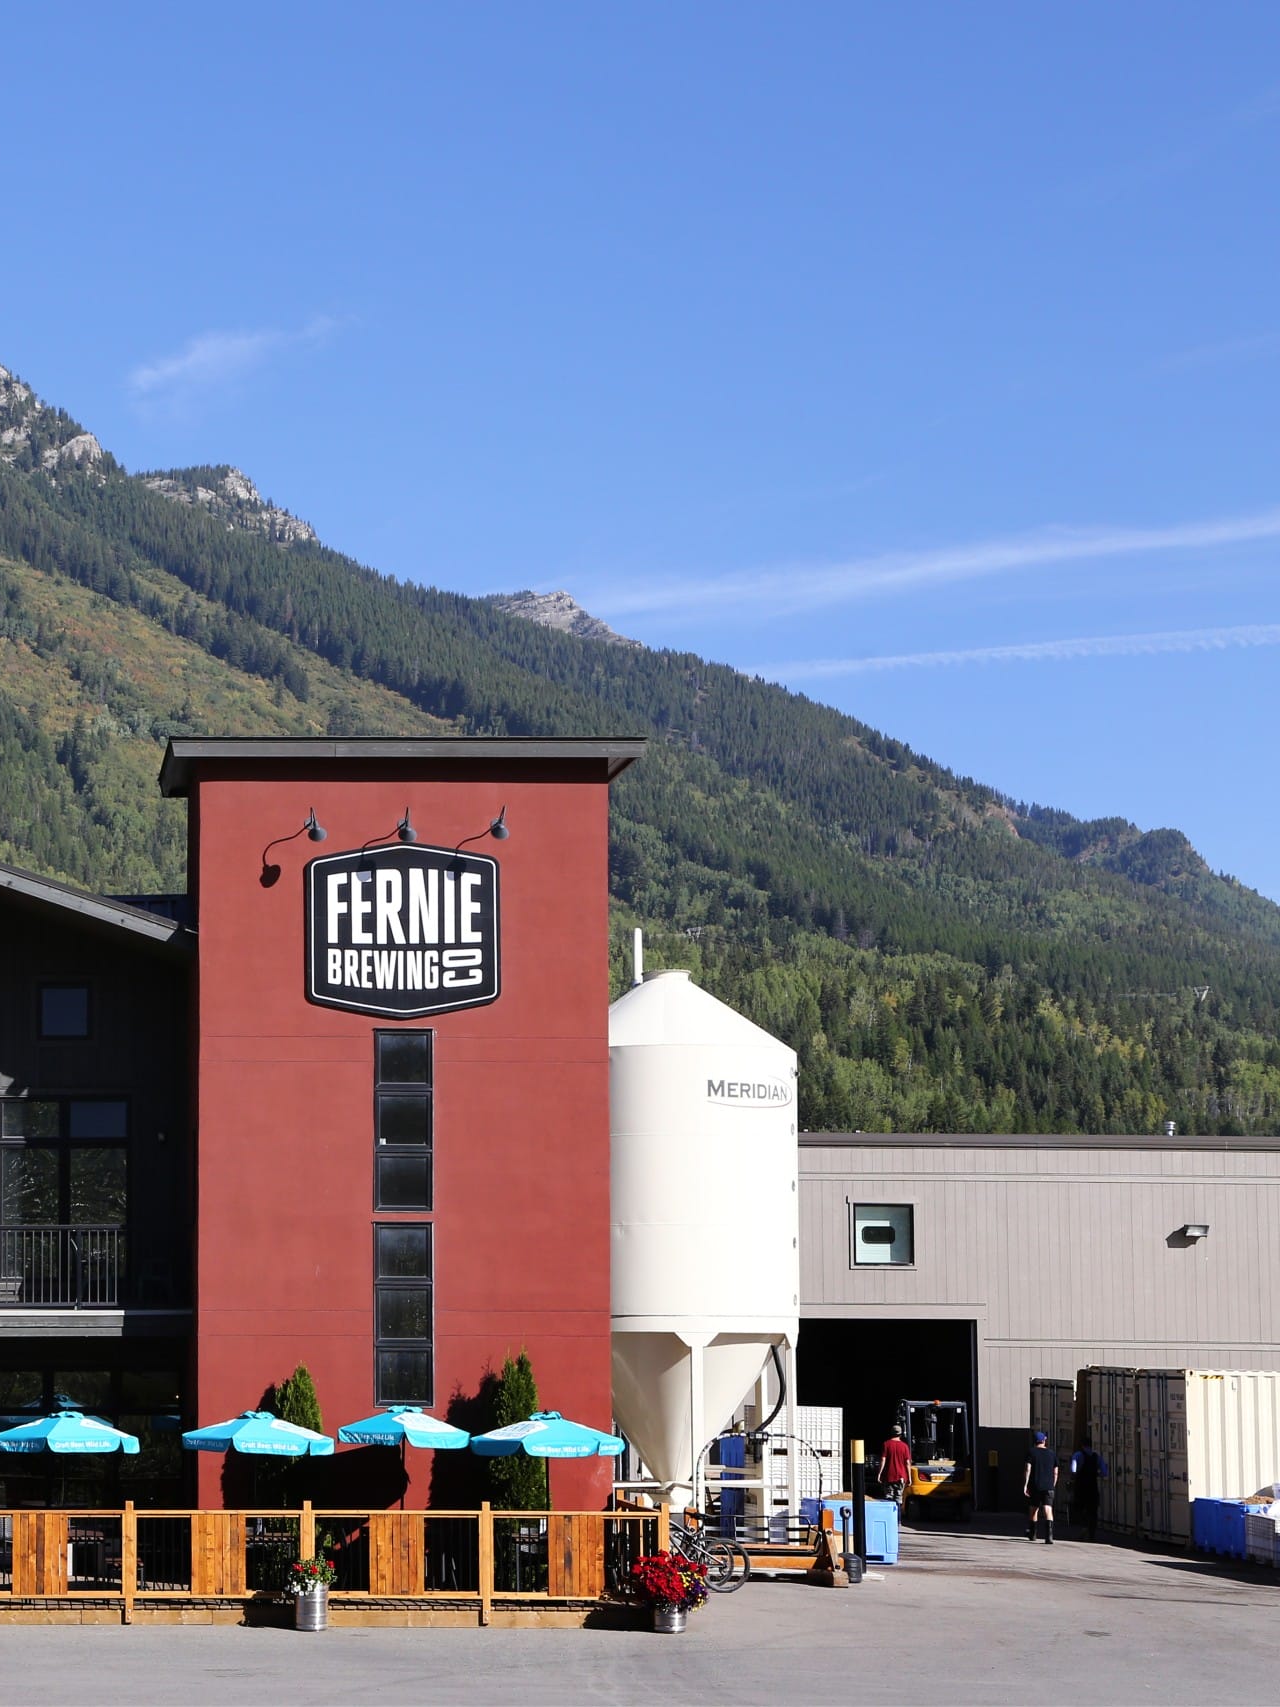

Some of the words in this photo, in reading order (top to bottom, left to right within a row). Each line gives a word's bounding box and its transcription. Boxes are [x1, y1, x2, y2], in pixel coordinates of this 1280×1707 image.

[327, 868, 483, 945] FERNIE
[327, 948, 440, 990] BREWING
[442, 948, 483, 988] CO
[707, 1079, 788, 1101] MERIDIAN
